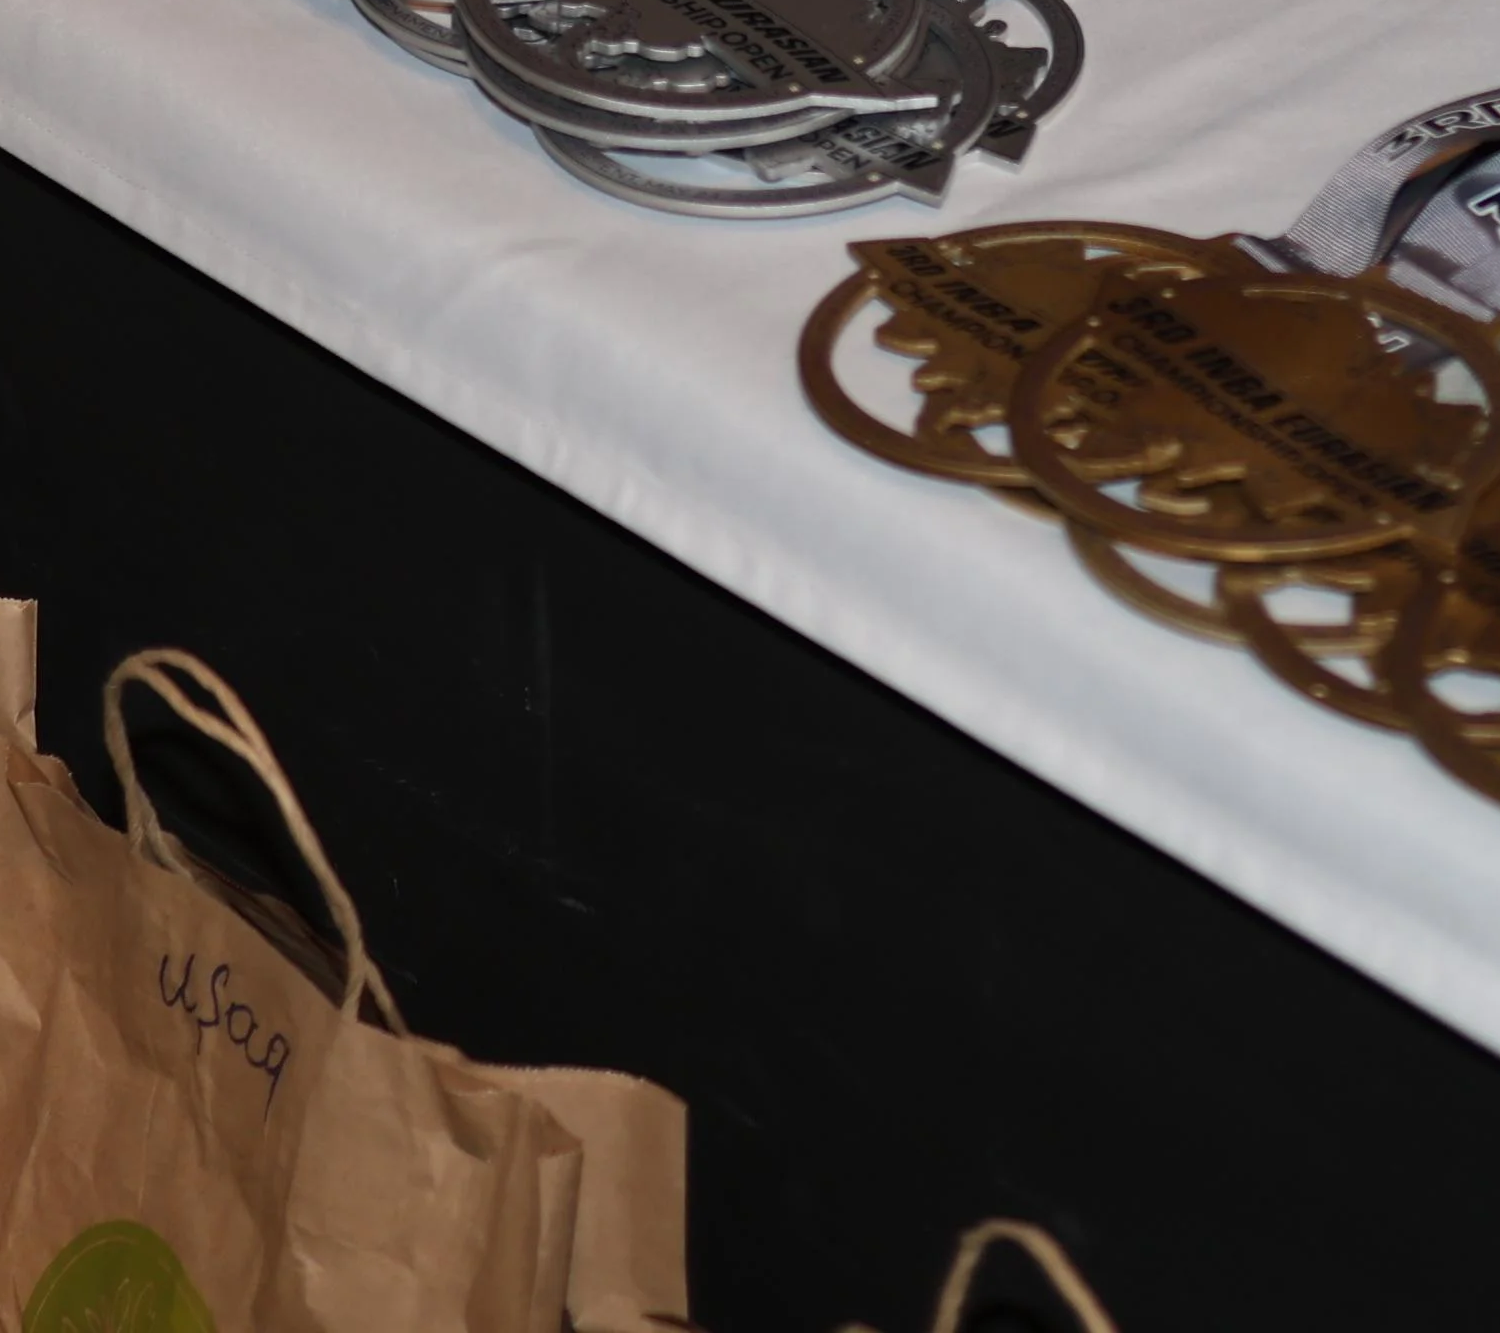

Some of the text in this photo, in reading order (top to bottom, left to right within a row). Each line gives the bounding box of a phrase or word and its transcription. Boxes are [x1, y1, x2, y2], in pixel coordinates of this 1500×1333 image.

[888, 282, 1030, 361] CHAMPION
[932, 277, 1042, 333] INBA
[1107, 296, 1459, 513] 3RD INBA EURASIAN
